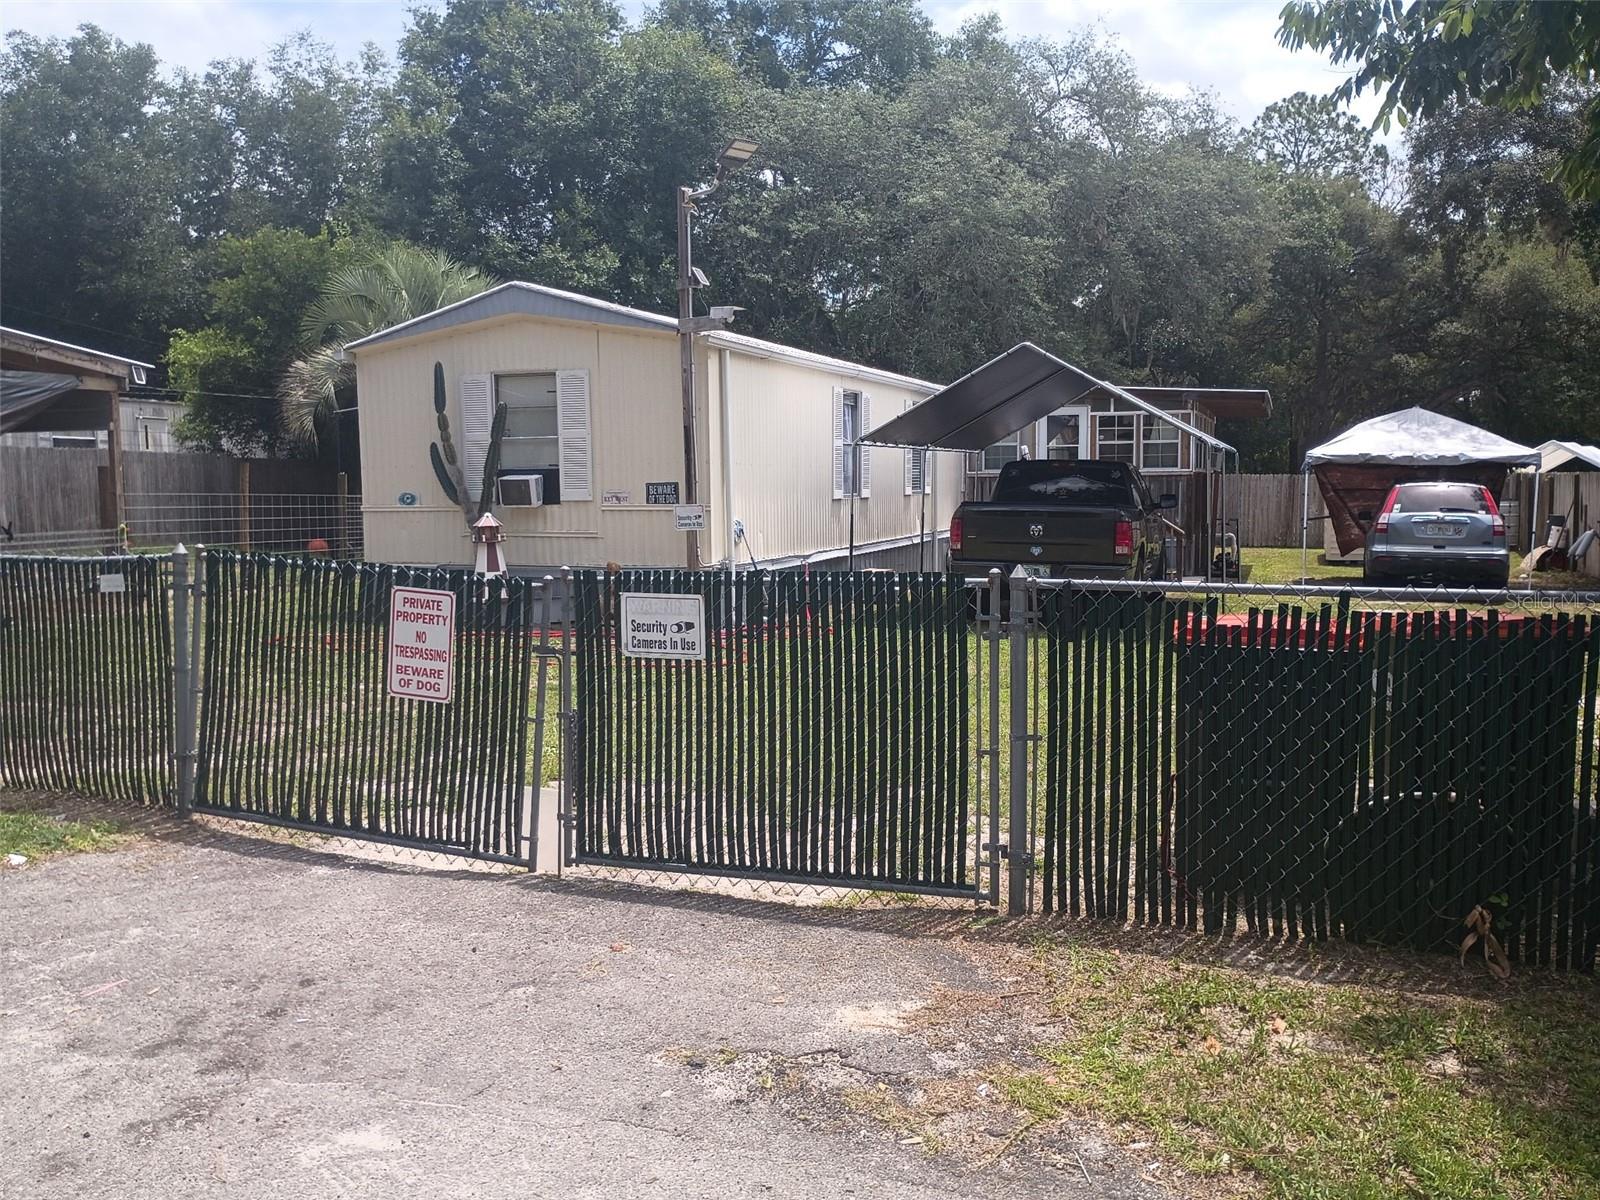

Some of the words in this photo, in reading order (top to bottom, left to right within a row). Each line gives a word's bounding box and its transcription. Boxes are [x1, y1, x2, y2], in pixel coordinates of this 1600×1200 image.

[649, 485, 676, 495] BEWARE
[649, 495, 656, 504] OF
[656, 495, 666, 504] THE
[666, 495, 677, 504] DOG
[403, 596, 443, 611] PRIVATE
[396, 610, 448, 626] PROPERTY
[631, 619, 667, 636] Security
[415, 631, 427, 643] NO
[631, 635, 667, 650] Cameras
[670, 637, 678, 650] In
[680, 638, 696, 650] Use
[395, 644, 447, 662] TRESPASSING
[396, 664, 444, 680] BEWARE
[398, 678, 413, 689] OF
[416, 680, 441, 692] DOG
